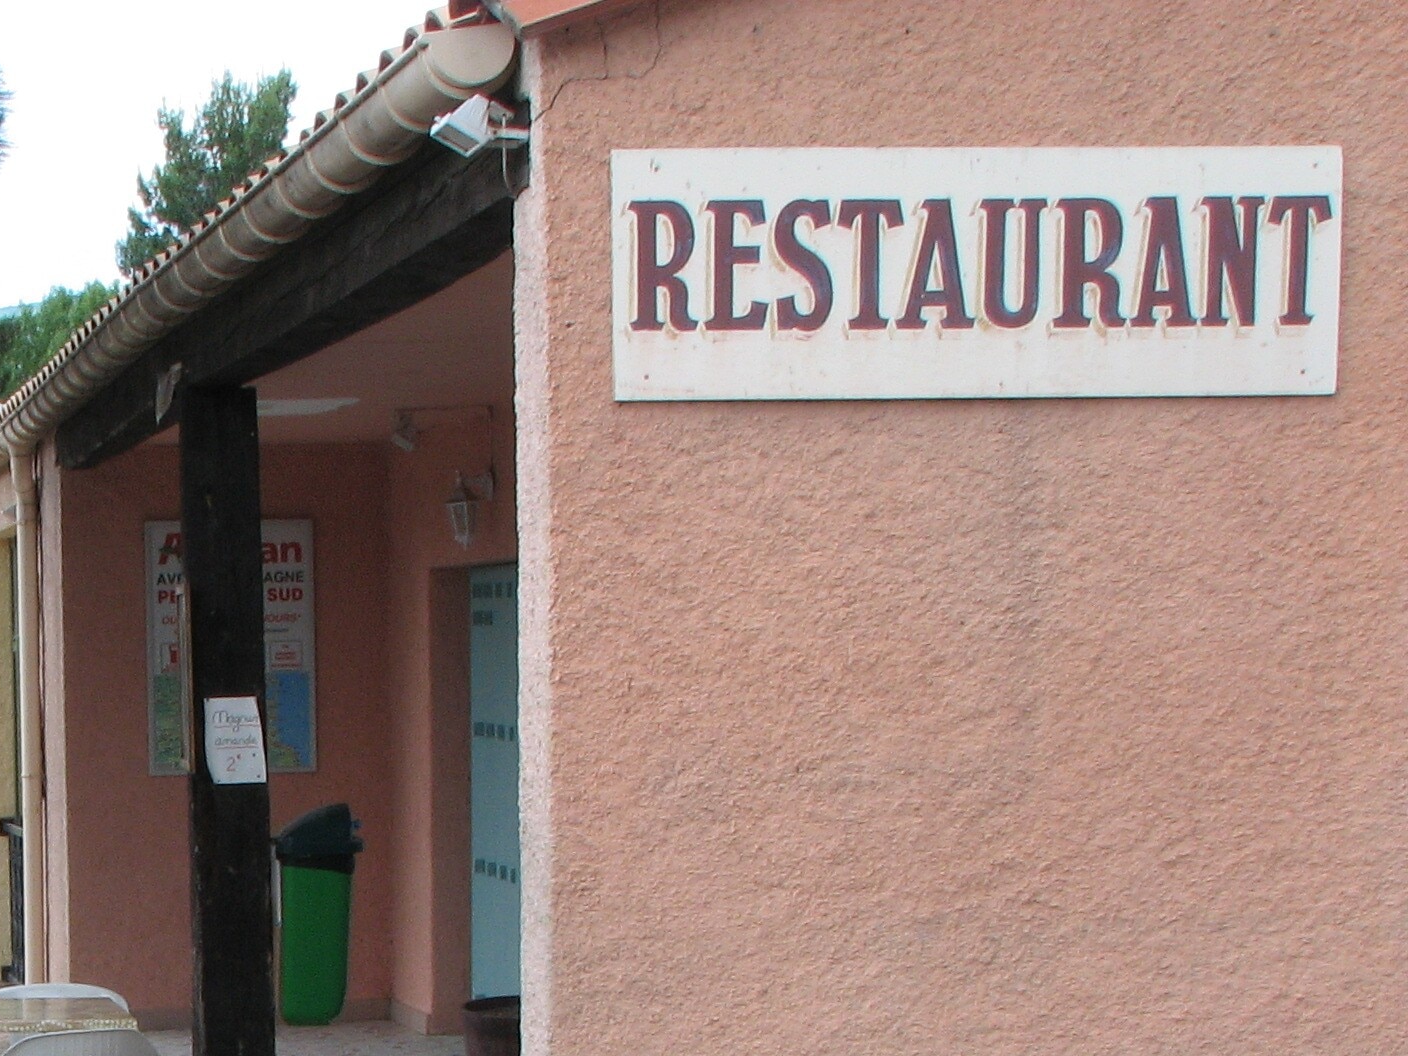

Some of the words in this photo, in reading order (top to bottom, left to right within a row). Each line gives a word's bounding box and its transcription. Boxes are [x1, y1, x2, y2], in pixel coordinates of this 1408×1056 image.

[625, 194, 1333, 332] RESTAURANT
[263, 570, 304, 584] AGNE
[266, 587, 304, 602] SUD
